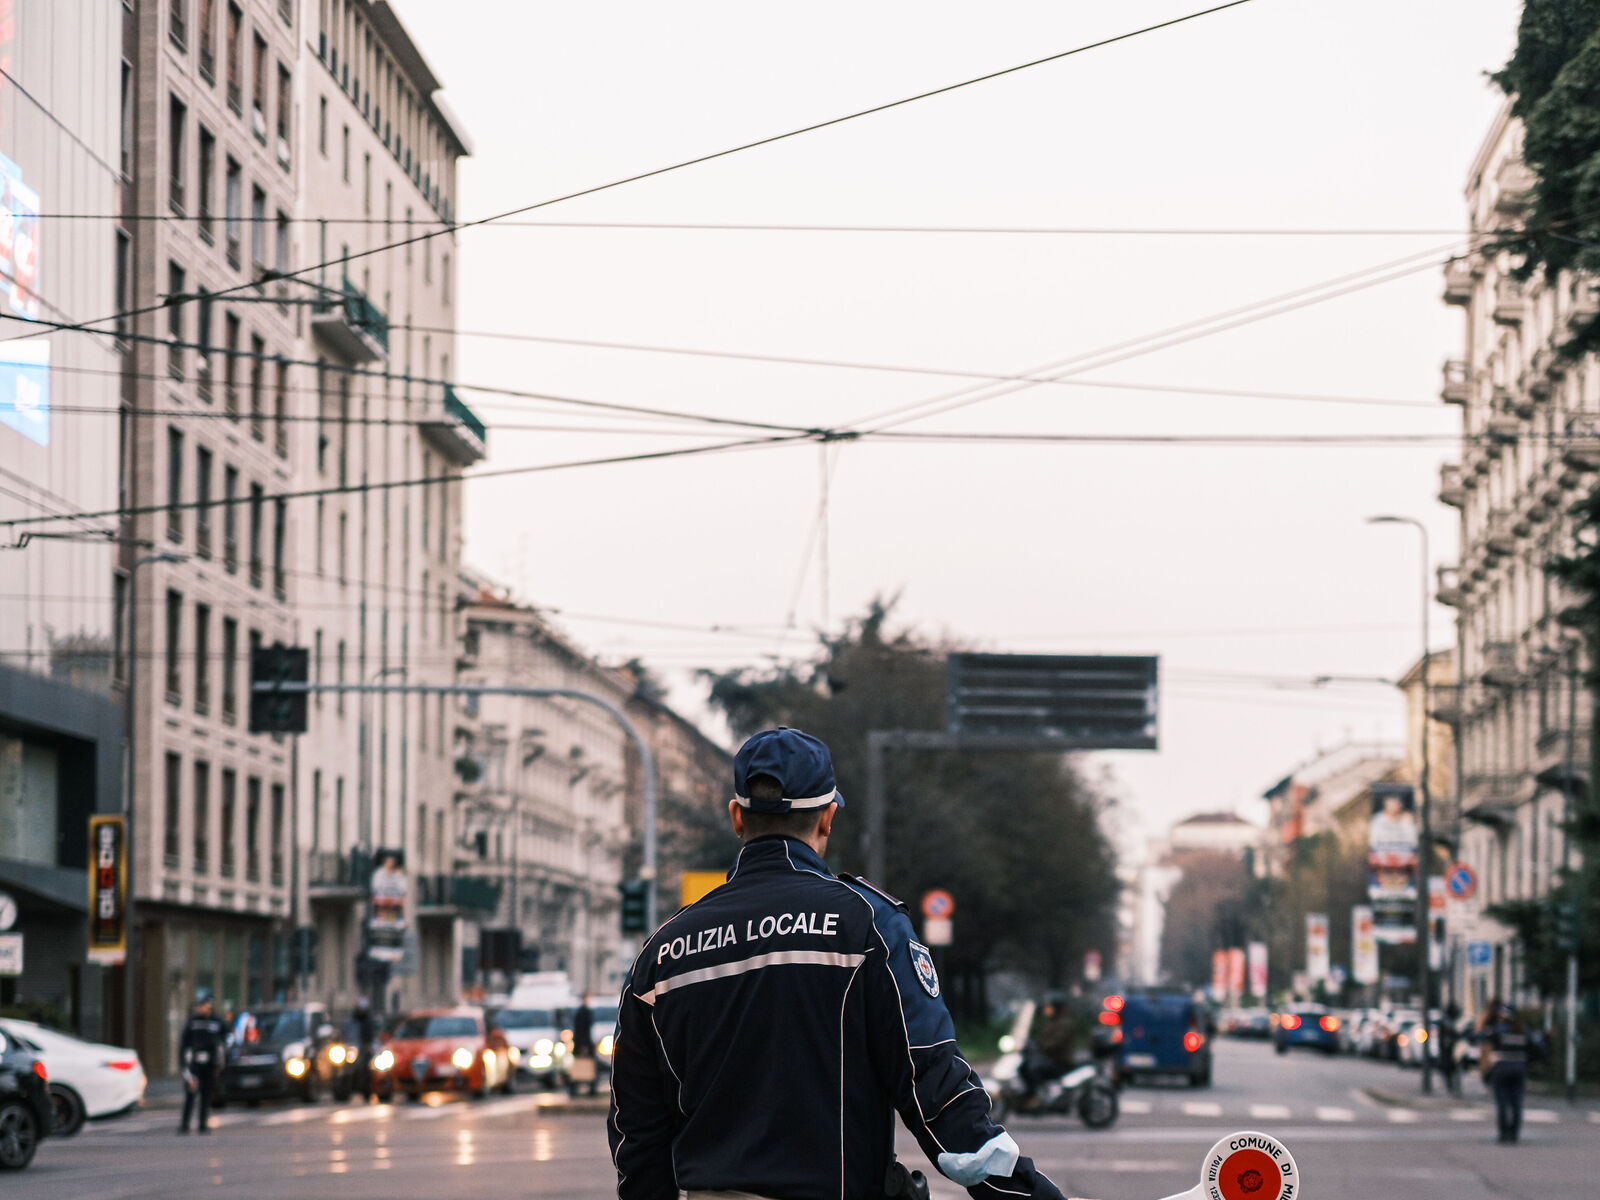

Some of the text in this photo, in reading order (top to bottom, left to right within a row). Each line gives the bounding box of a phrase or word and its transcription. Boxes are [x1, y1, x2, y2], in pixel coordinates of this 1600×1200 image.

[657, 912, 840, 965] POLIZIA LOCALE
[1208, 1155, 1223, 1182] POLIZIA
[1230, 1137, 1282, 1160] COMUNE
[1281, 1163, 1293, 1177] DI
